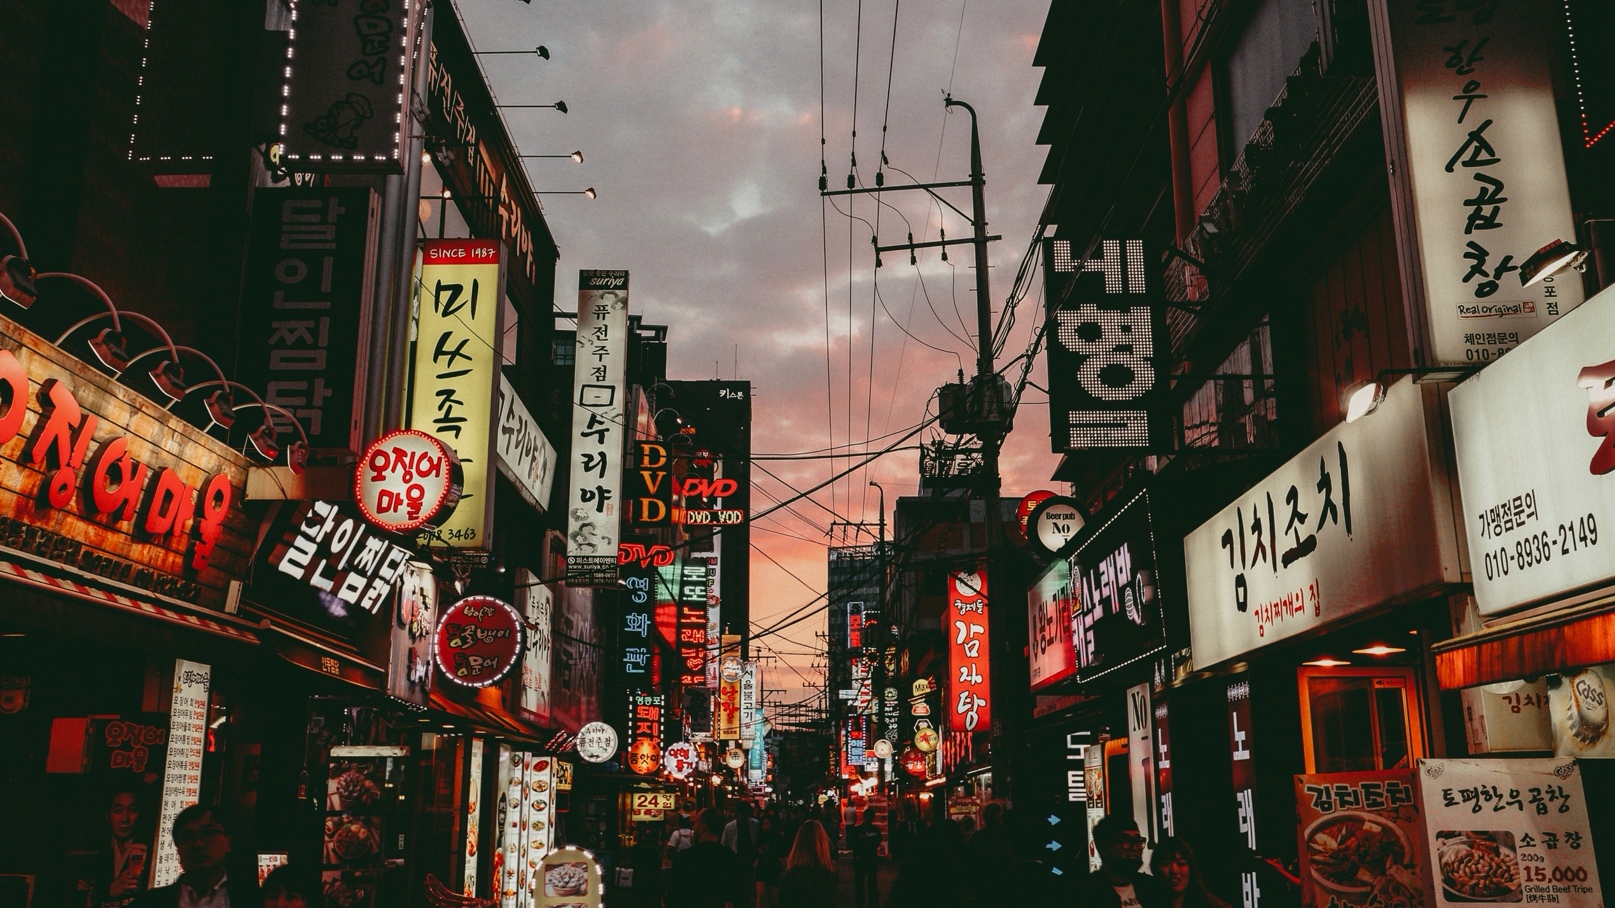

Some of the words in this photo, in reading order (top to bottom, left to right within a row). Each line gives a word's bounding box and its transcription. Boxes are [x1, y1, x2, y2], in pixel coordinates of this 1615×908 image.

[430, 248, 466, 260] SINCE
[471, 247, 496, 259] 1987
[589, 276, 625, 289] suriya
[1458, 304, 1481, 315] Real
[589, 305, 610, 381] 퓨전주점
[1464, 332, 1519, 346] 체인점문의
[369, 447, 444, 485] 오징어
[577, 413, 612, 514] 수리야
[639, 444, 667, 522] DVD
[681, 478, 738, 499] DVD
[375, 486, 427, 521] 마을
[1478, 489, 1539, 539] 가맹점문의
[1046, 512, 1060, 520] Beer
[1062, 512, 1075, 521] pub
[1221, 440, 1354, 613] 김치조치
[448, 528, 476, 541] 3463
[1484, 512, 1599, 581] 010-8936-2149
[618, 543, 674, 568] DVD
[1254, 588, 1306, 638] 김치찌개의
[1309, 577, 1322, 618] 집
[954, 620, 987, 732] 감자탕
[1580, 679, 1604, 707] Cass
[580, 737, 611, 748] 퓨전주점
[637, 795, 660, 808] 24
[1523, 866, 1589, 885] 15,000
[1524, 885, 1551, 895] Grilled
[1553, 885, 1572, 895] Beef
[1573, 885, 1594, 896] Tripe
